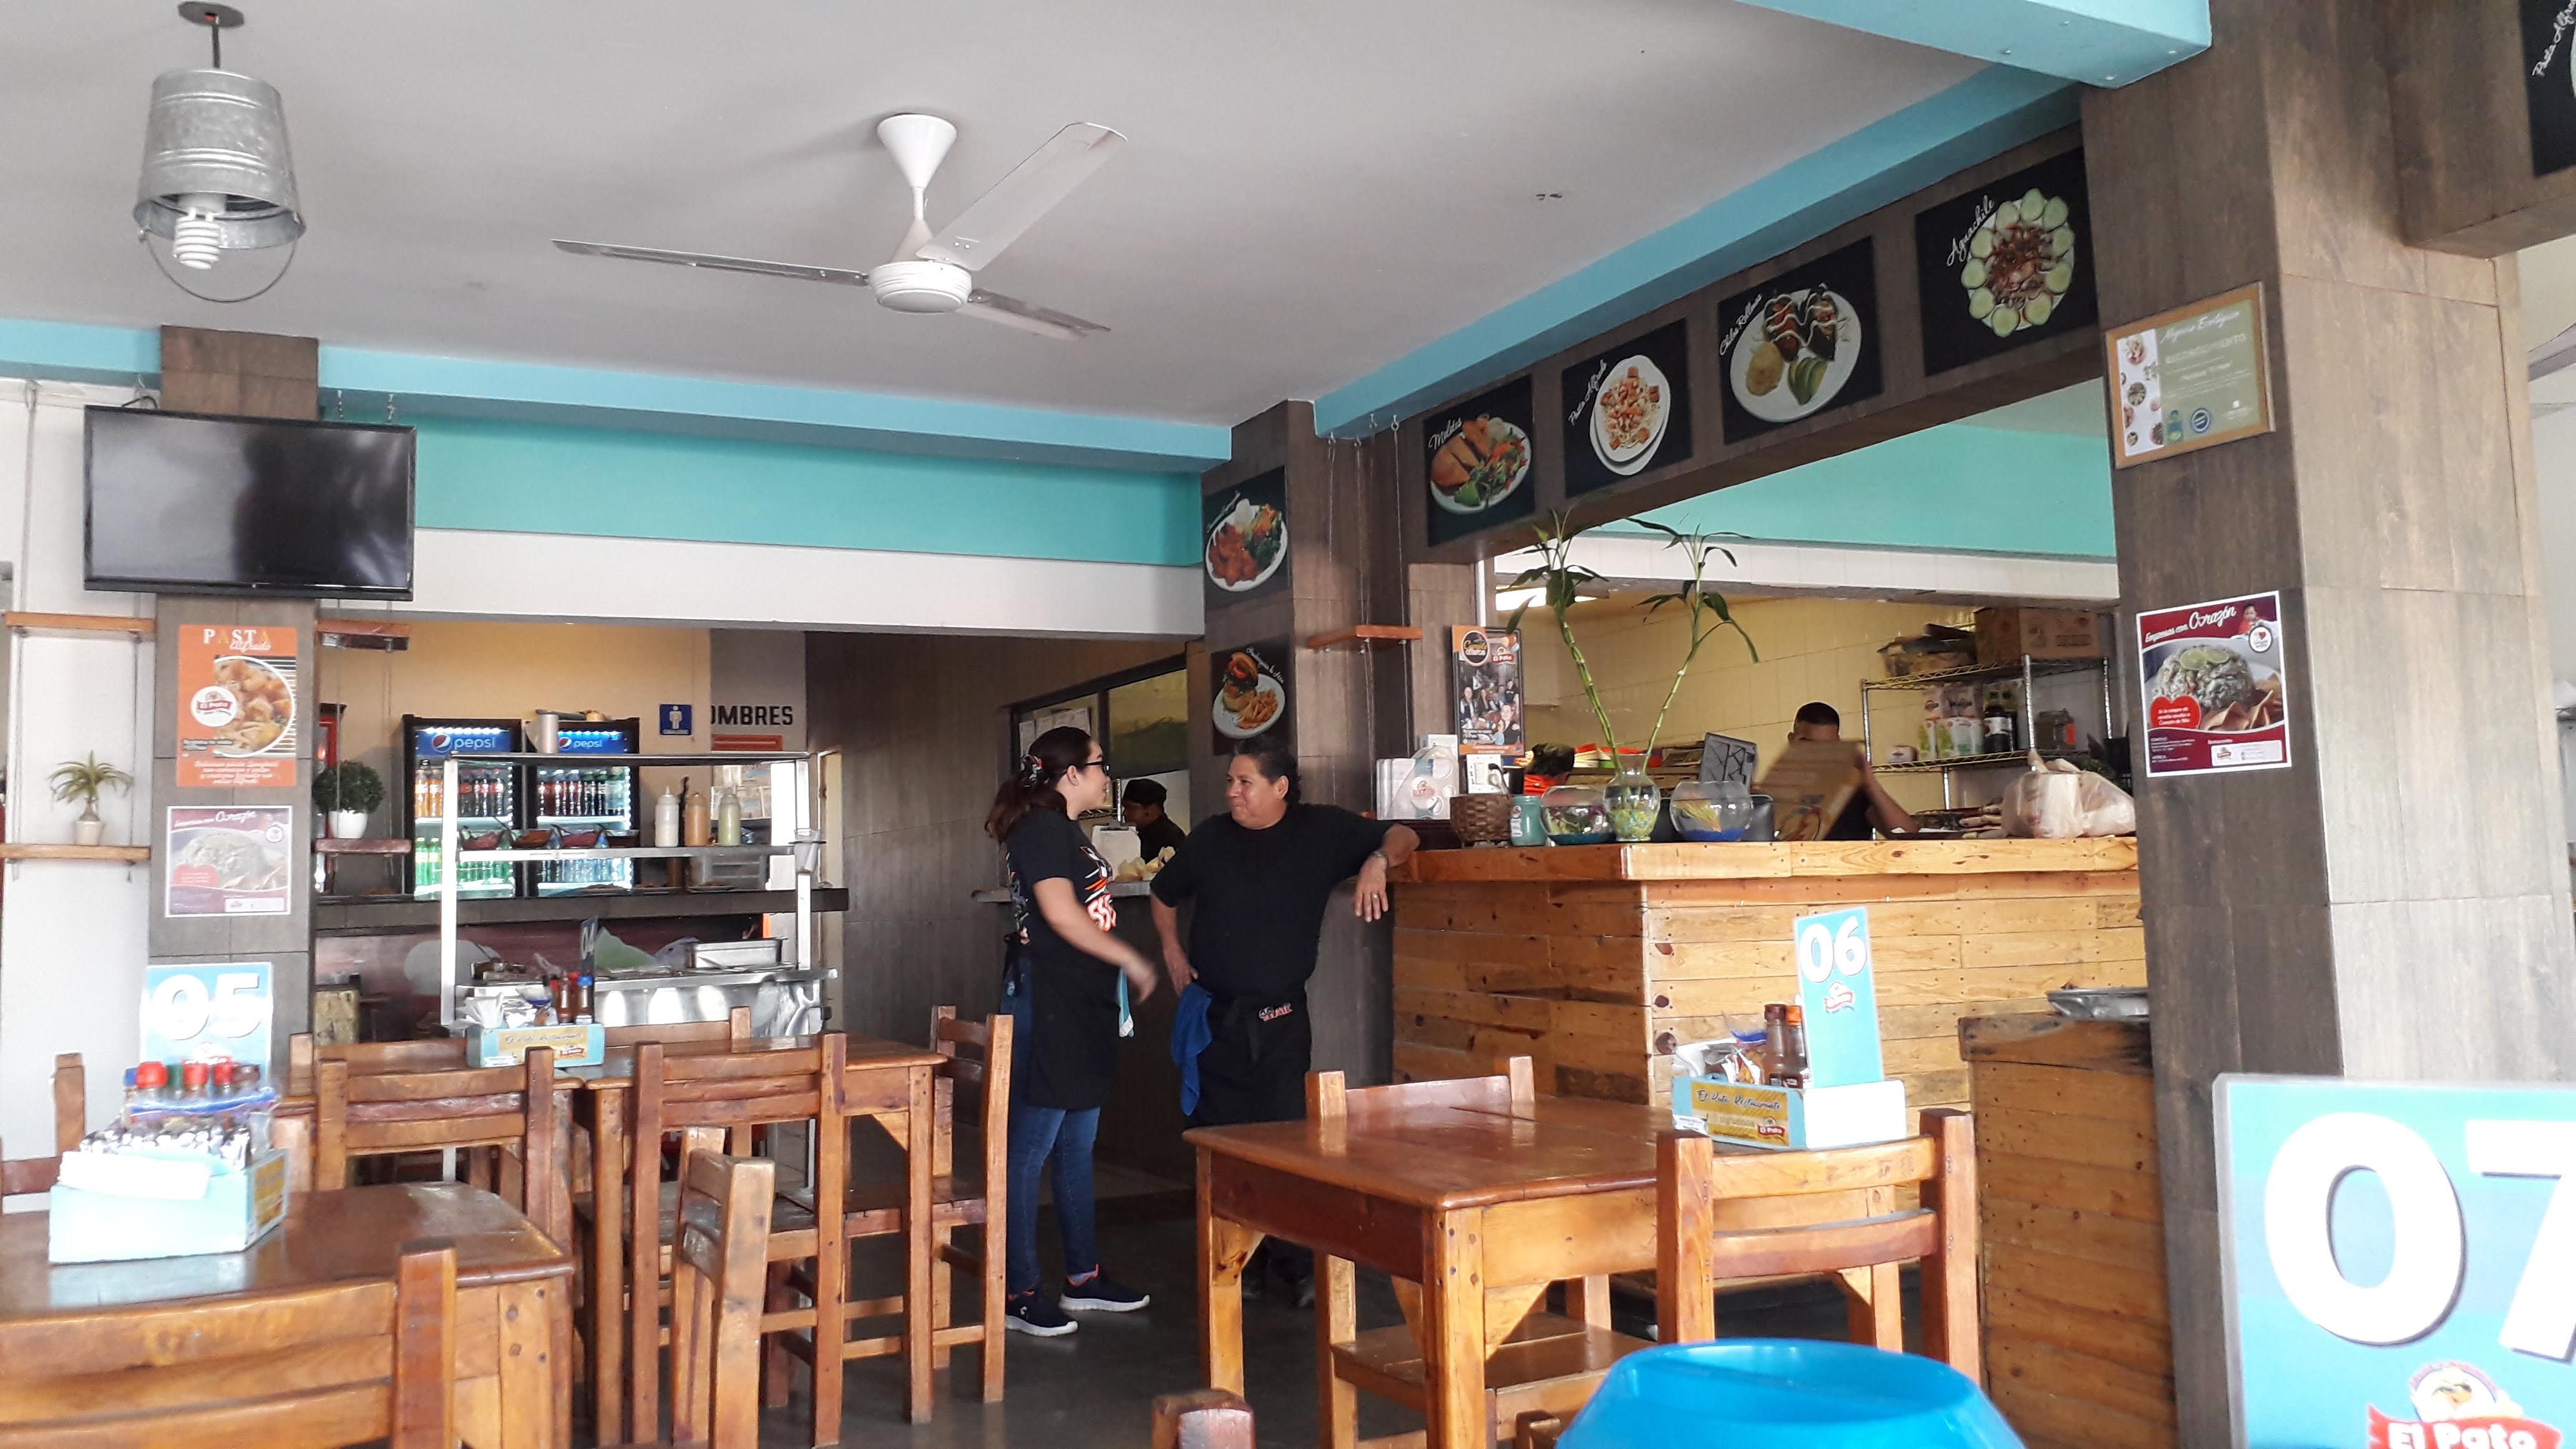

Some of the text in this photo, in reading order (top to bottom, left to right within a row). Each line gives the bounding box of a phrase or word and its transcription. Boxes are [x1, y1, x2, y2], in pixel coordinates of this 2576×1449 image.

[1947, 195, 1995, 267] Aguachile
[2188, 605, 2237, 628] Corazón
[203, 628, 271, 645] PASTA
[454, 736, 495, 749] pepsi
[573, 738, 603, 749] pepsi
[1800, 915, 1868, 983] 06
[153, 973, 261, 1041] 05
[2264, 1111, 2576, 1364] 07
[2389, 1422, 2538, 1449] El Pato
